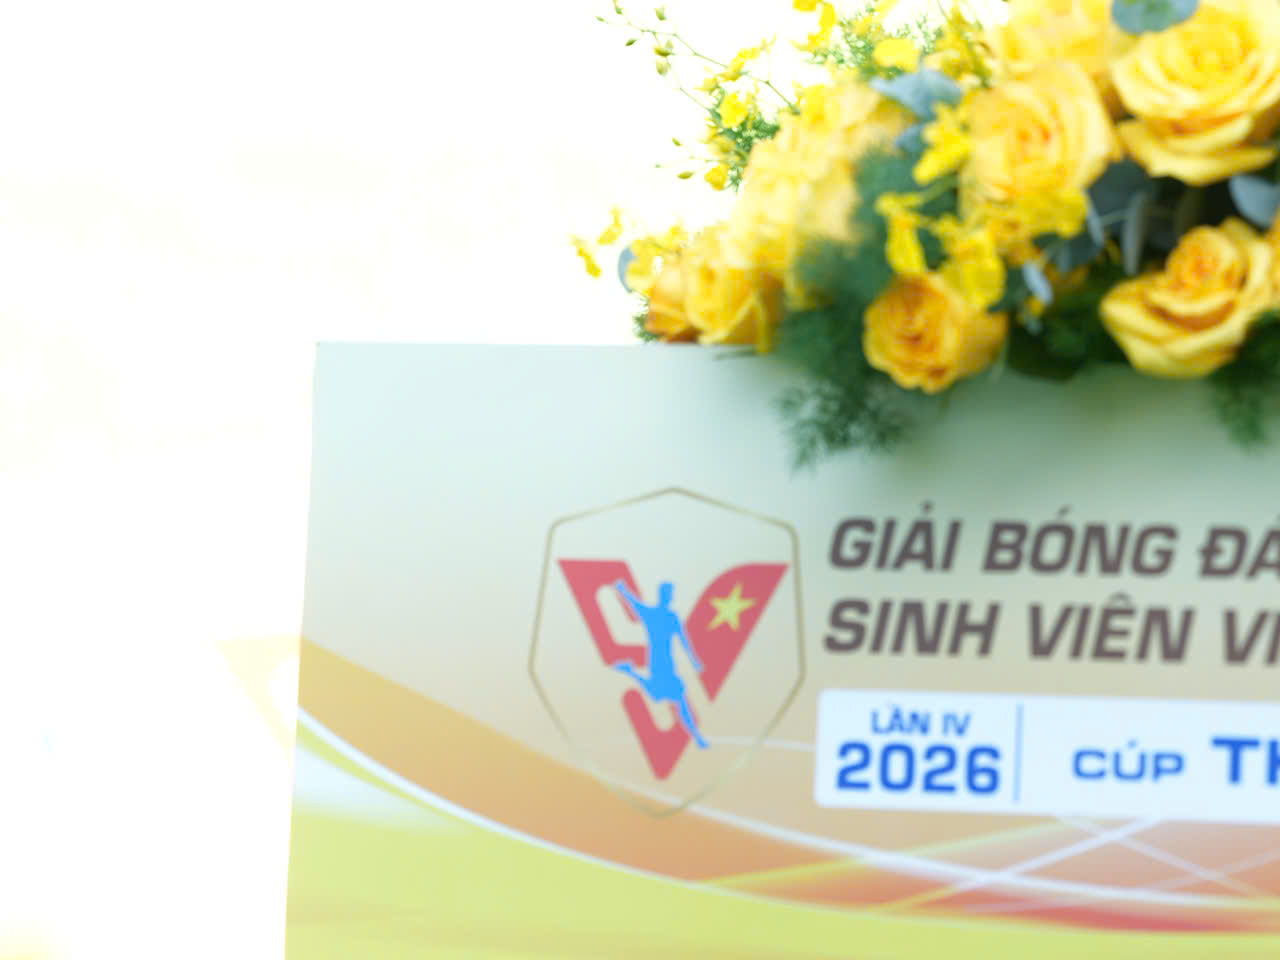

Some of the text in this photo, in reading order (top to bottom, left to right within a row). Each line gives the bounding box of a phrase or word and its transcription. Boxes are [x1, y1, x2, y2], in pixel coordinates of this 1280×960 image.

[829, 500, 962, 572] GIẢI
[982, 504, 1179, 578] BÓNG
[824, 598, 1001, 657] SINH
[1028, 592, 1195, 664] VIÊN
[941, 710, 973, 737] IV
[836, 741, 1001, 795] 2026
[1072, 739, 1186, 782] CÚP
